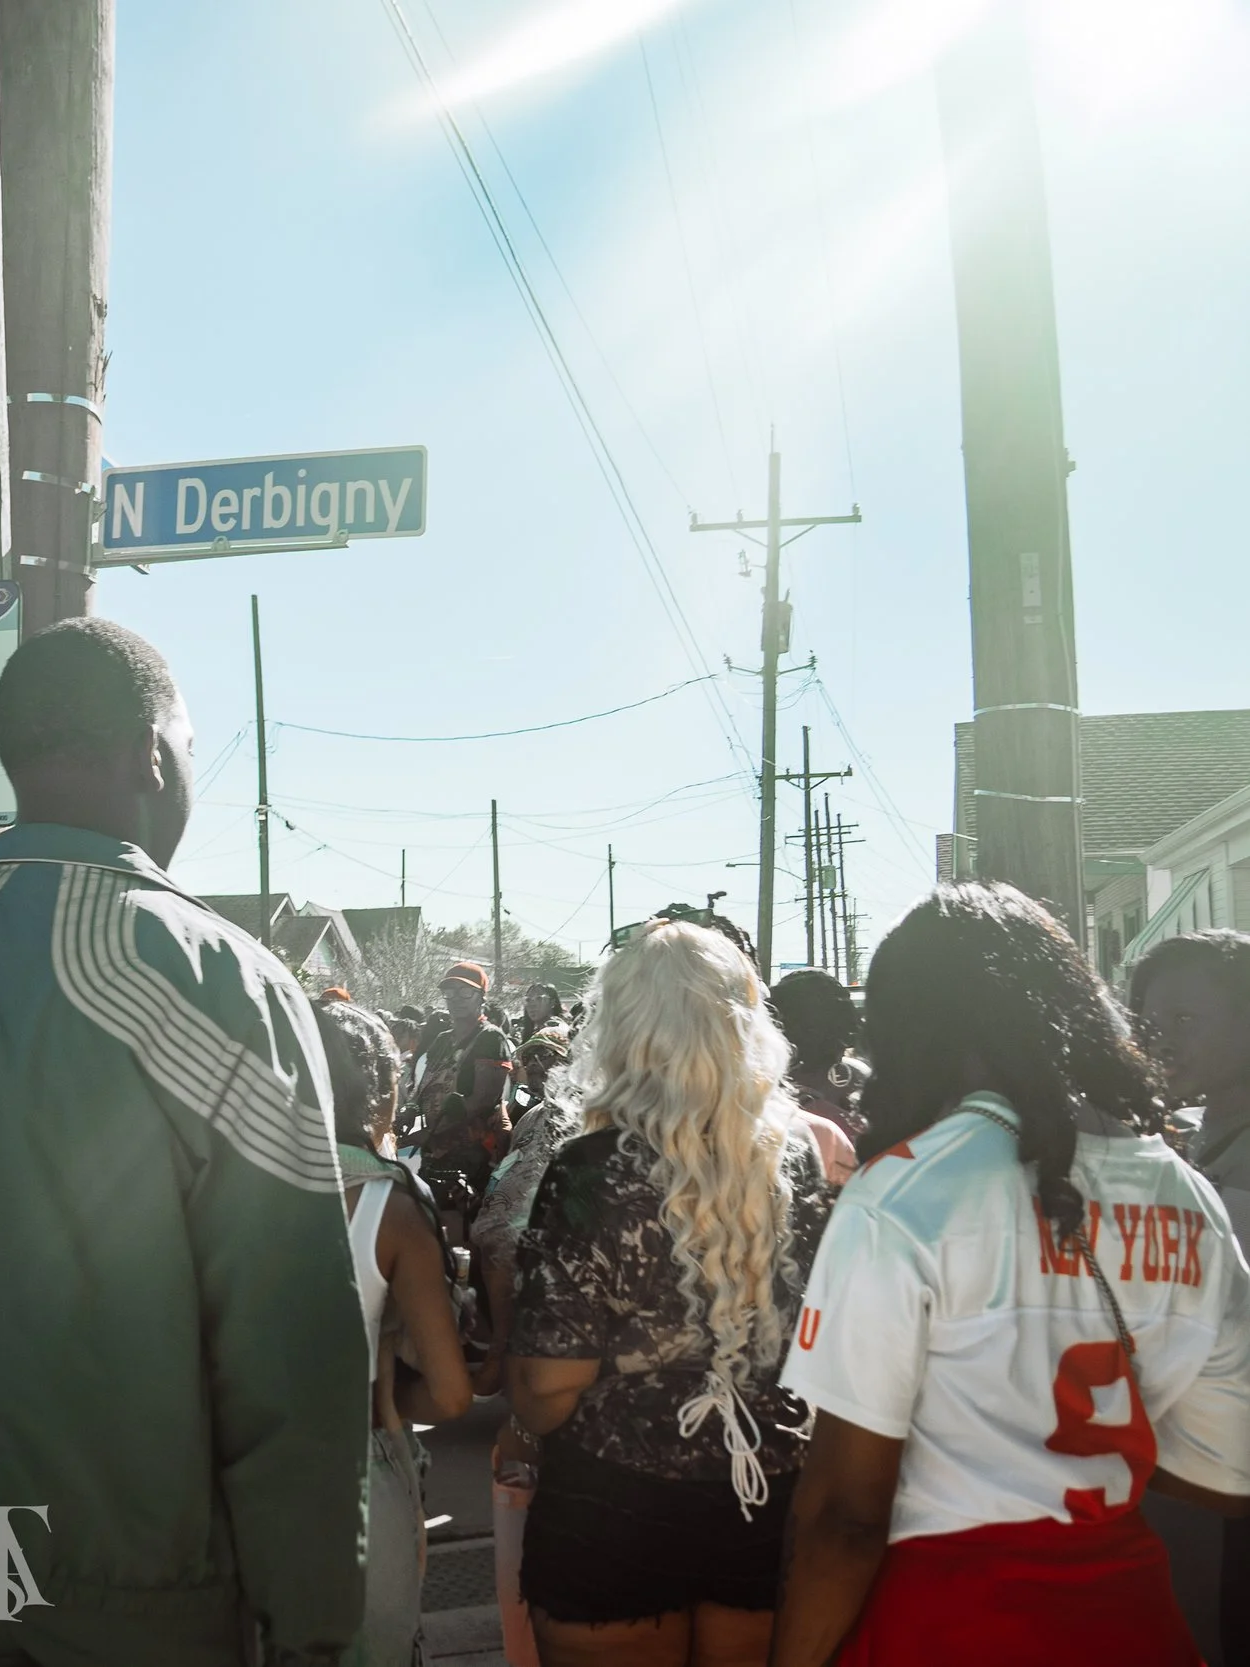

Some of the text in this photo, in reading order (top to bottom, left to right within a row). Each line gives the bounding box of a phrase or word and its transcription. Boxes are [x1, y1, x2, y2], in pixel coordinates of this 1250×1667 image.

[111, 469, 413, 539] N Derbigny
[1113, 1204, 1205, 1288] YORK
[798, 1306, 822, 1351] U
